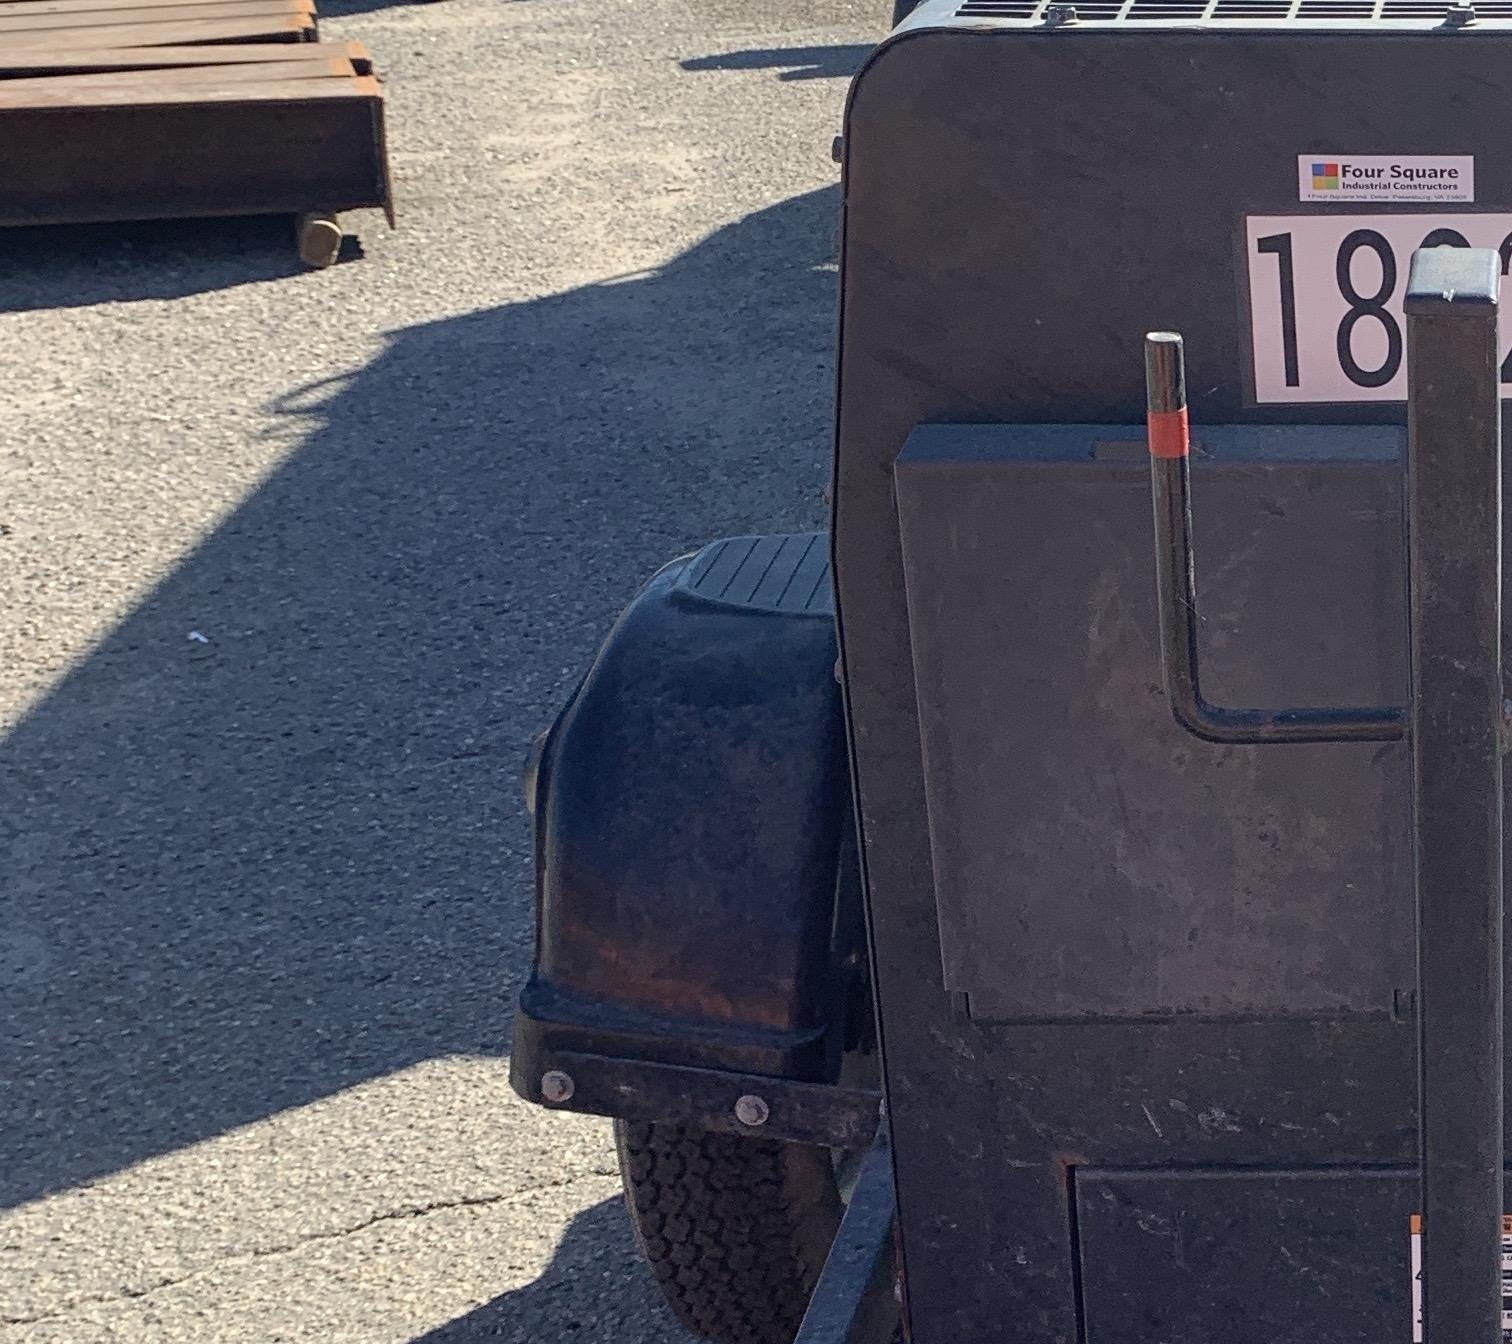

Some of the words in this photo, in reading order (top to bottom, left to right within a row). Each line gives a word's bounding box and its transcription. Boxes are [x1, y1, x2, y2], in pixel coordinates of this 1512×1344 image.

[1341, 164, 1387, 179] Four
[1390, 164, 1459, 181] Square
[1342, 182, 1391, 190] Industrial
[1393, 182, 1458, 191] Constructors
